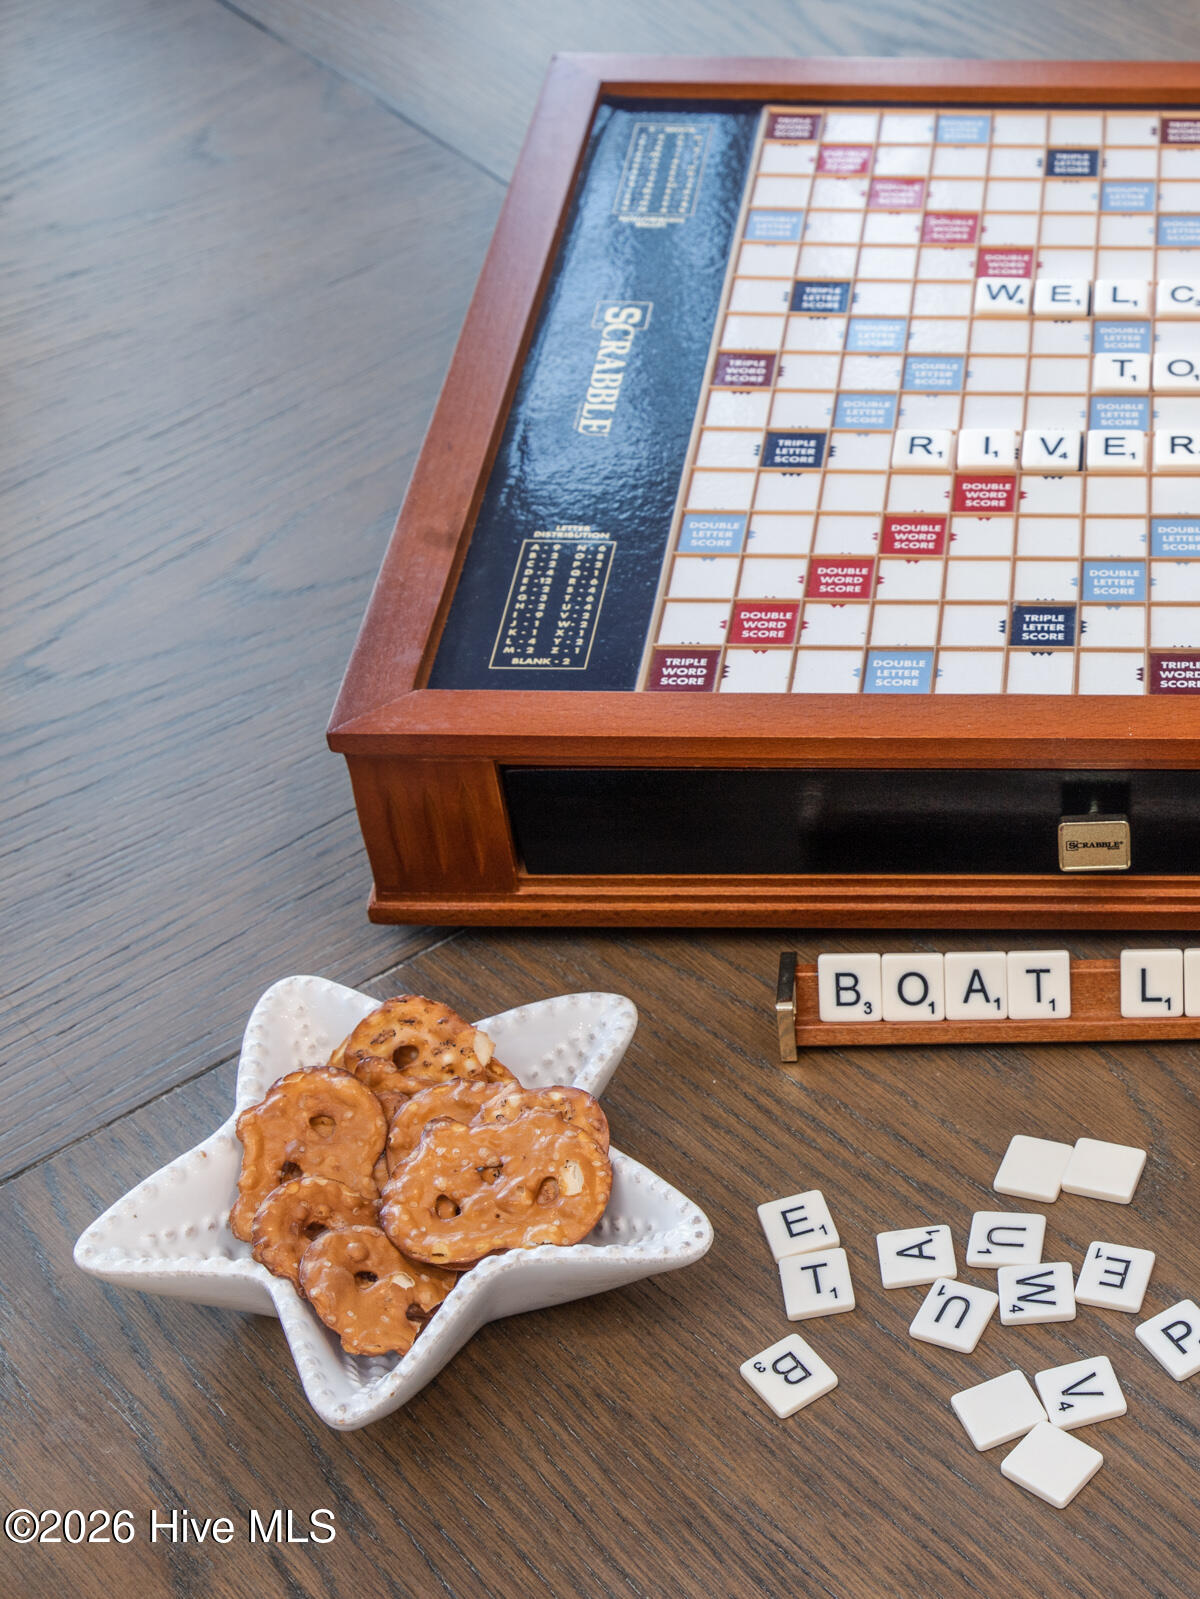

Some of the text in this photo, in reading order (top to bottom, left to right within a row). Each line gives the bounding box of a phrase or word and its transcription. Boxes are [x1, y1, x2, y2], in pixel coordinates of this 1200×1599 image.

[577, 305, 643, 434] SCRABBLE
[1112, 359, 1196, 378] TO
[907, 435, 1196, 456] RIVER
[962, 482, 1011, 490] DOUBLE
[965, 491, 1007, 499] WORD
[965, 499, 1005, 507] SCORE
[689, 521, 740, 529] DOUBLE
[891, 523, 941, 531] DOUBLE
[533, 531, 610, 539] DISTRIBUTION
[692, 530, 733, 538] LETTER
[894, 532, 937, 540] WORD
[690, 539, 732, 547] SCORE
[893, 542, 934, 550] SCORE
[817, 567, 868, 575] DOUBLE
[1089, 568, 1140, 577] DOUBLE
[819, 576, 863, 584] WORD
[1093, 578, 1135, 586] LETTER
[819, 585, 861, 593] SCORE
[1093, 587, 1134, 596] SCORE
[740, 610, 792, 619] DOUBLE
[1023, 613, 1064, 621] TRIPLE
[742, 620, 787, 629] WORD
[1022, 623, 1064, 631] LETTER
[741, 630, 784, 639] SCORE
[1021, 633, 1064, 641] SCORE
[665, 657, 707, 666] TRIPLE
[873, 659, 925, 668] DOUBLE
[661, 667, 707, 676] WORD
[876, 668, 919, 677] LETTER
[659, 677, 705, 686] SCORE
[875, 678, 918, 687] SCORE
[834, 968, 1051, 1007] BOAT
